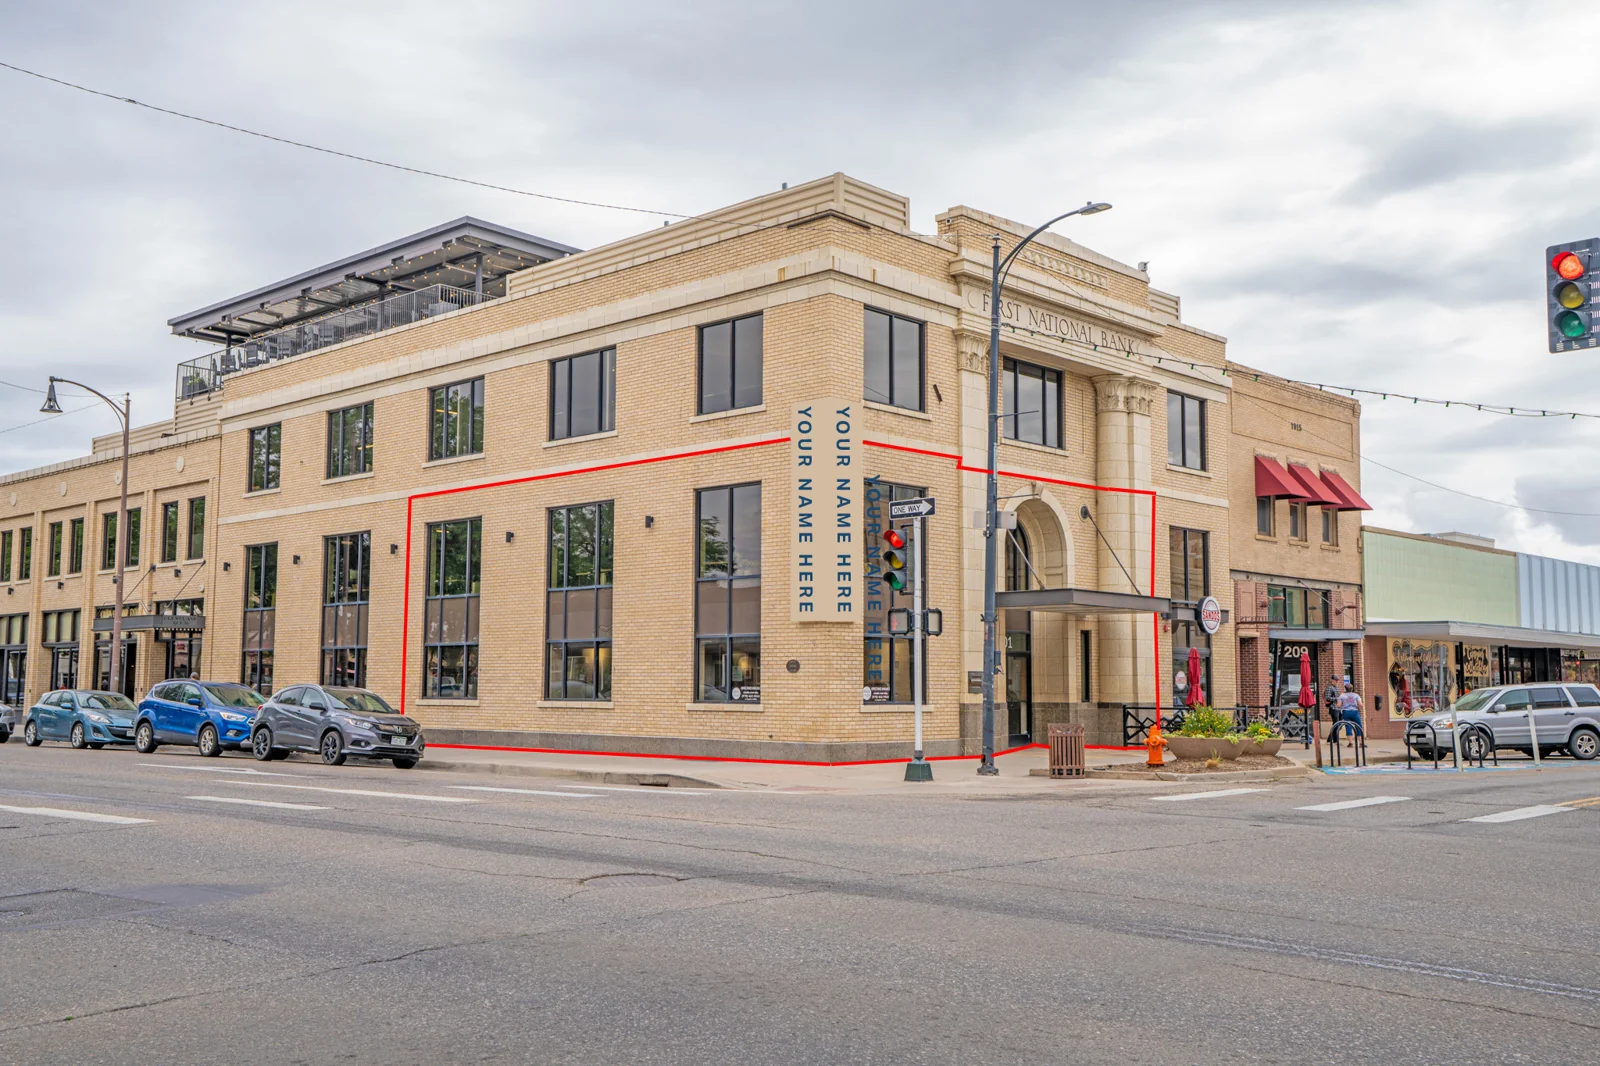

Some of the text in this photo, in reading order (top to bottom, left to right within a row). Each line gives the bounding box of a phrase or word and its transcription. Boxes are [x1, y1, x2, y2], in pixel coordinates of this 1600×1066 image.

[982, 293, 1135, 355] FRST NATIONAL BANK
[893, 504, 921, 514] ONE WAY
[1284, 646, 1308, 658] 209
